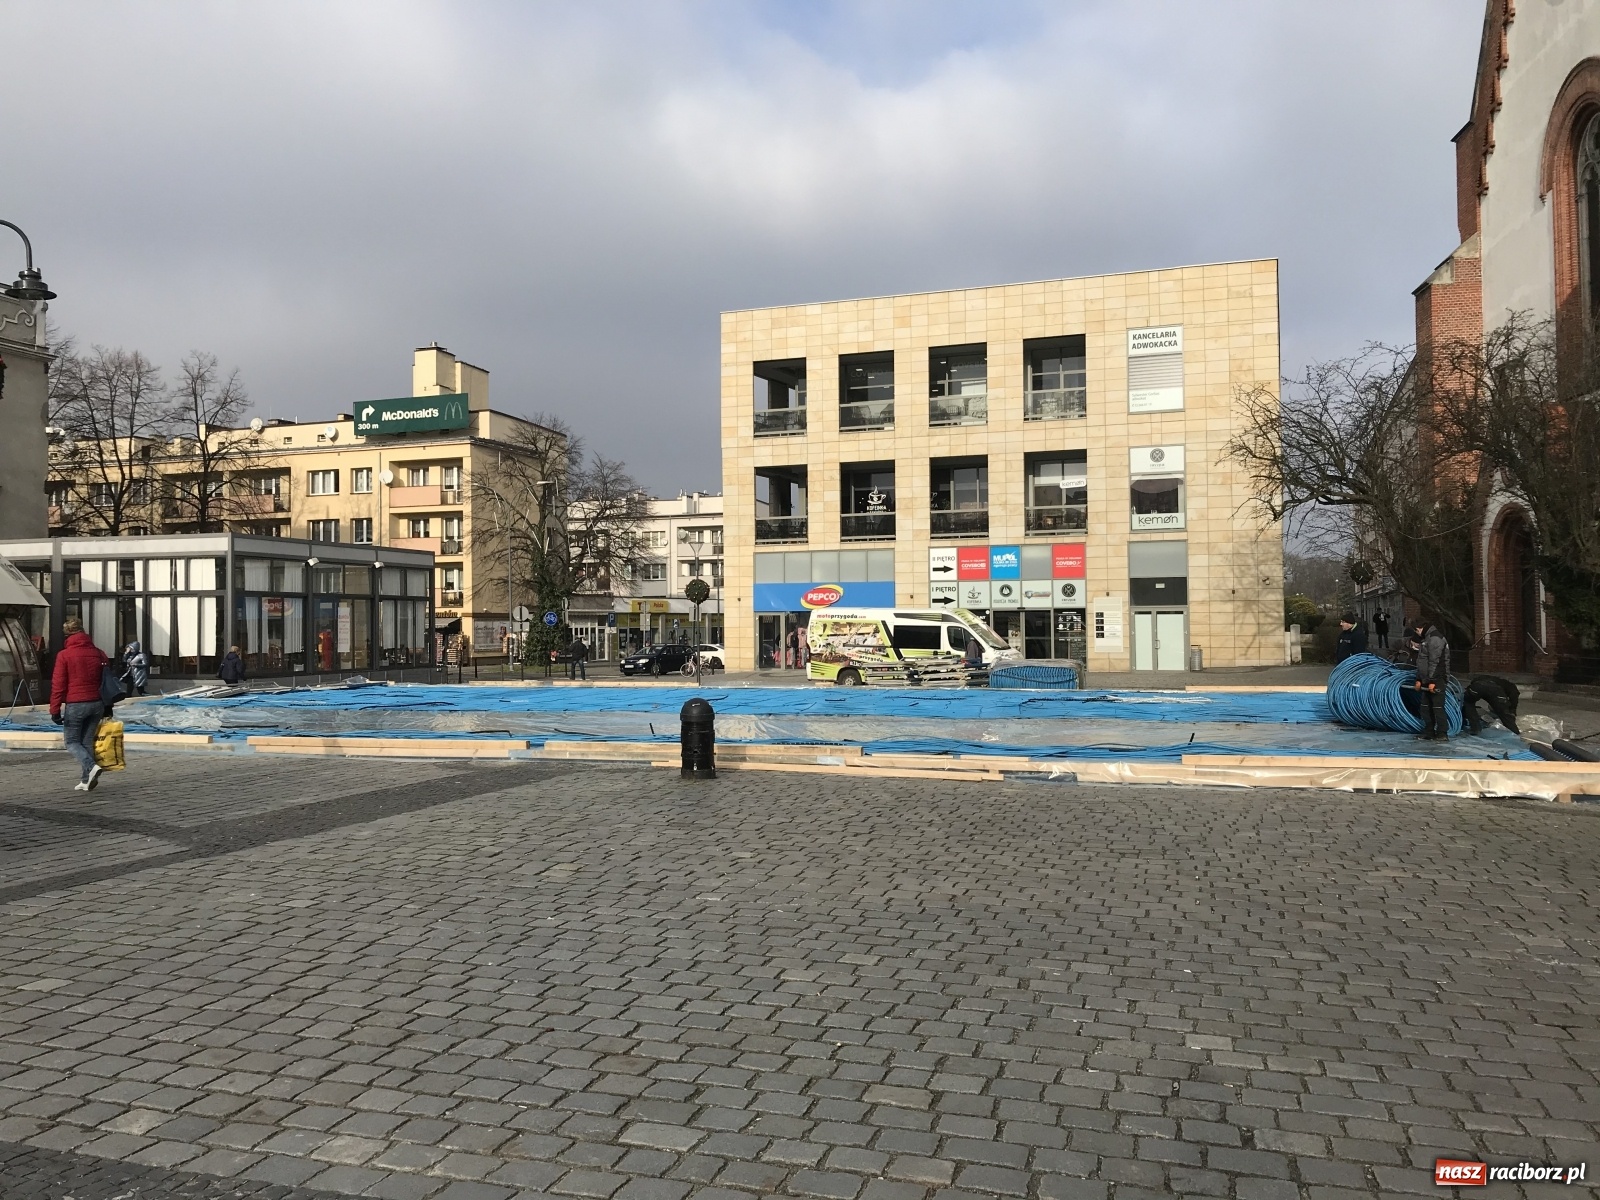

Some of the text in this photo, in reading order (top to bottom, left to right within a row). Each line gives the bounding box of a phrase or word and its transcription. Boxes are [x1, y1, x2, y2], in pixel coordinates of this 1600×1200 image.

[1132, 331, 1177, 340] KANCELARIA
[1131, 340, 1178, 350] ADWOKACKA
[381, 408, 439, 421] McDonald's
[807, 592, 838, 601] PEPCO
